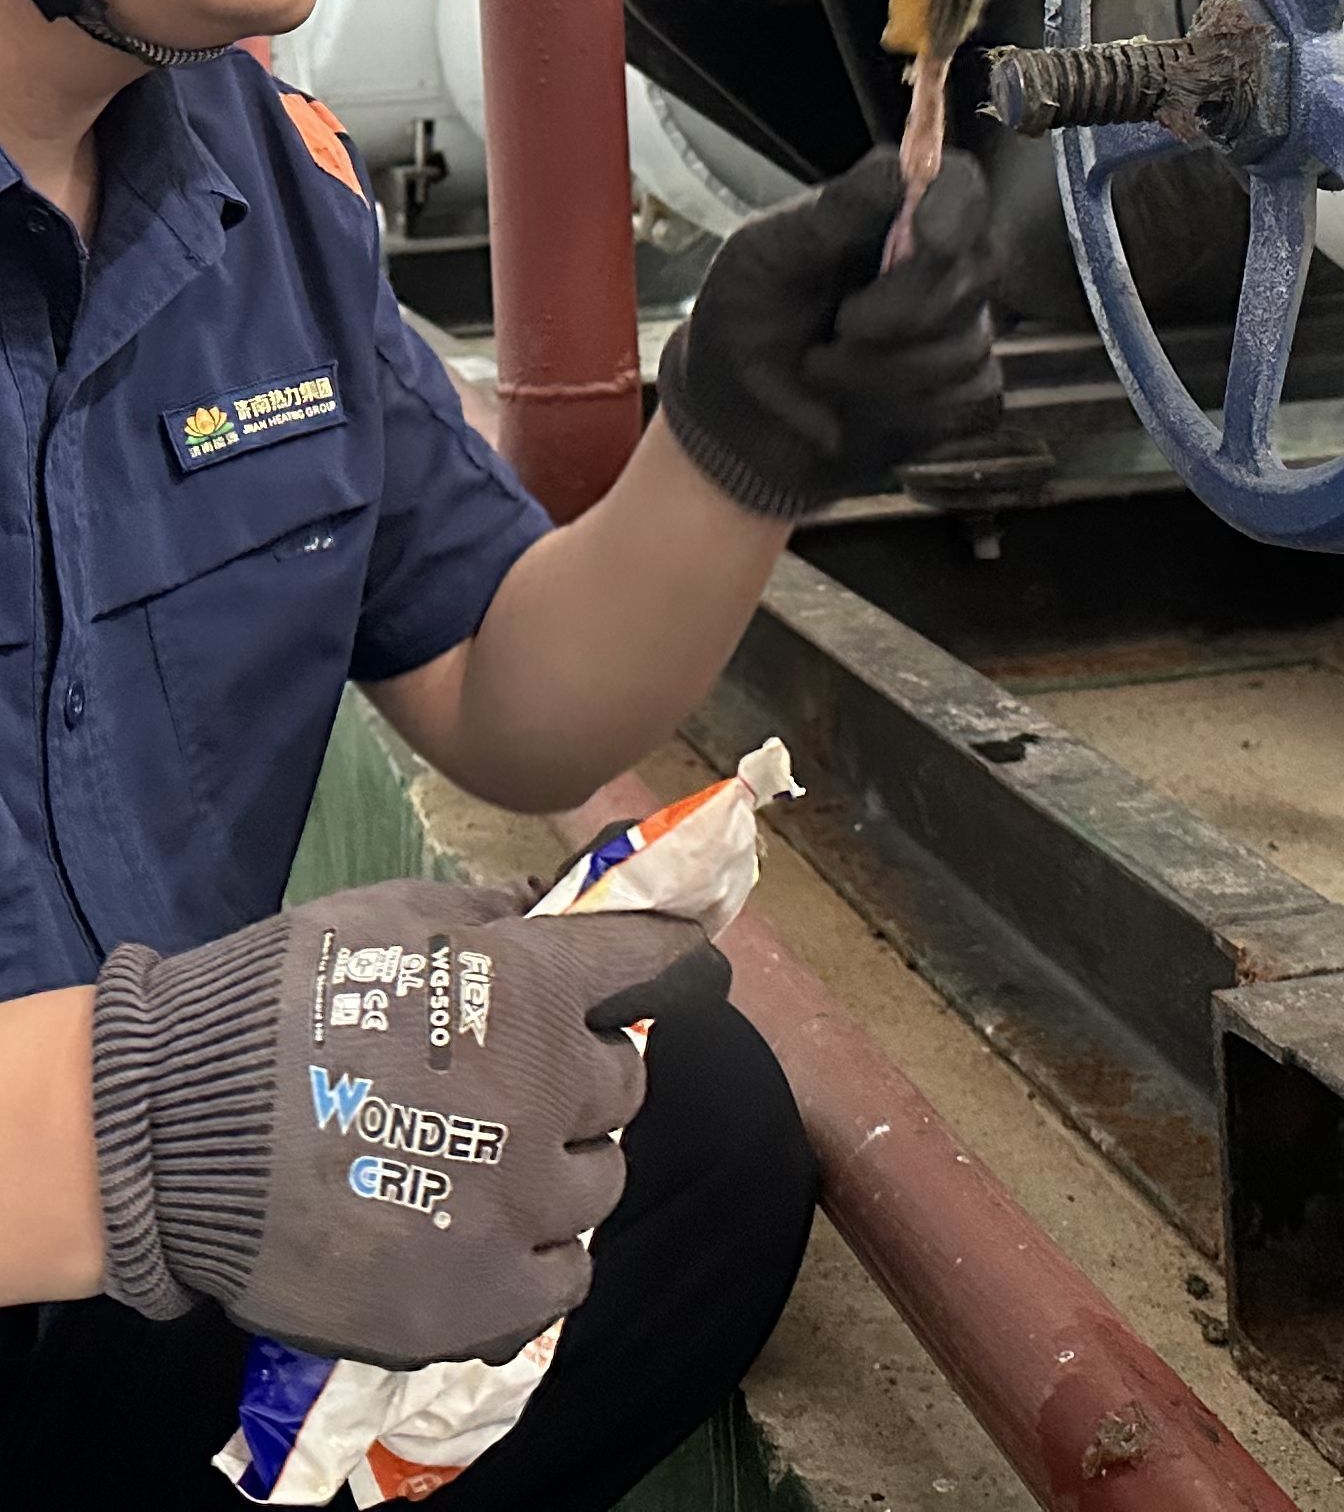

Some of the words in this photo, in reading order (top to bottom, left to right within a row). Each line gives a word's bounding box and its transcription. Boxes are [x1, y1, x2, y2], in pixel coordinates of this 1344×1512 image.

[233, 376, 334, 421] 济南热力集团
[306, 399, 338, 419] GROUP
[429, 945, 451, 1047] WG-500
[308, 1064, 510, 1166] WONDER
[348, 1154, 454, 1215] GRIP
